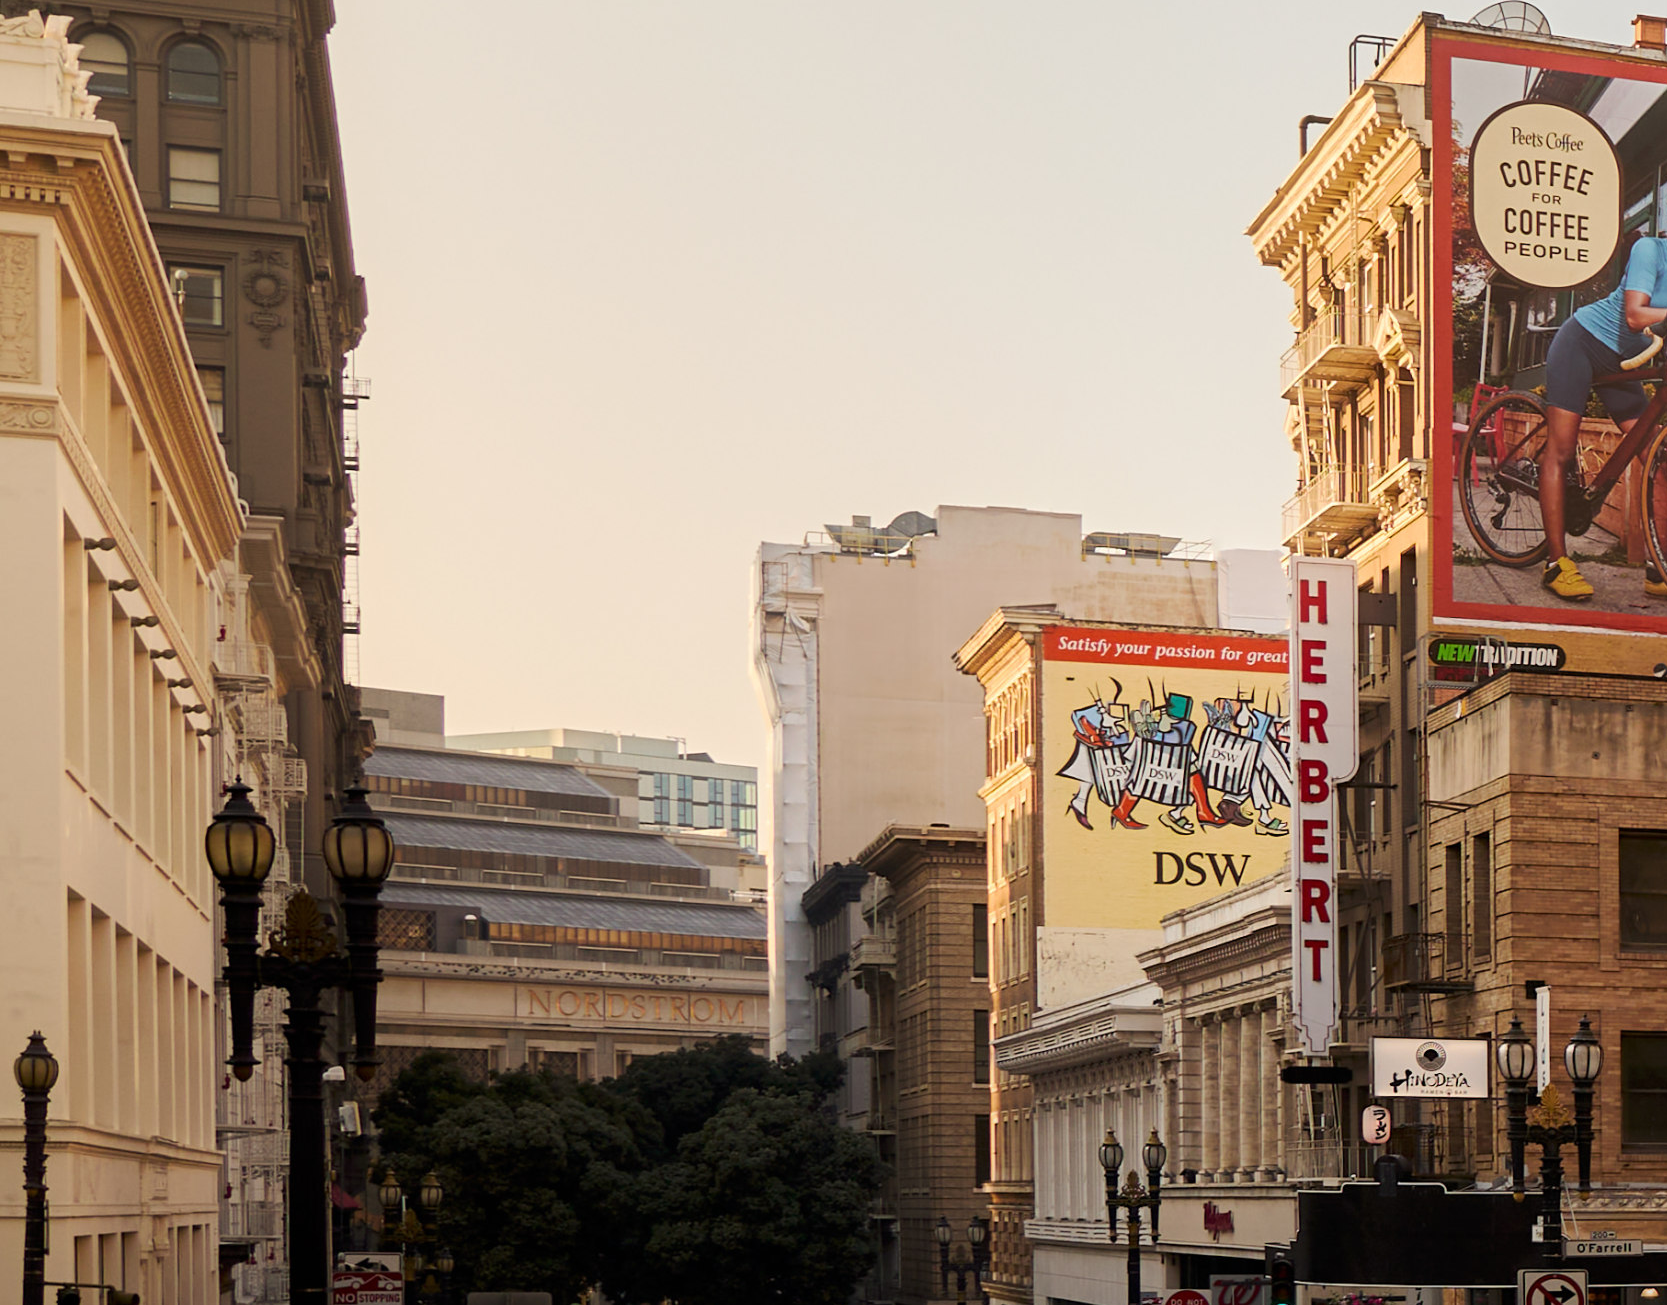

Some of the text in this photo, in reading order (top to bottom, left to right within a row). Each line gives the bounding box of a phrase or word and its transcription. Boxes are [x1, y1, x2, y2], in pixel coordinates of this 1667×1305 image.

[1546, 132, 1584, 153] Coffee
[1500, 160, 1594, 195] COFFEE
[1532, 193, 1562, 205] FOR
[1504, 208, 1590, 242] COFFEE
[1504, 241, 1589, 263] PEOPLE
[1058, 636, 1288, 665] Satisfy your passion for great
[1211, 748, 1238, 762] DSW
[1106, 767, 1178, 781] DSW DSW
[1300, 578, 1329, 982] HERBERT
[1153, 851, 1251, 887] DSW
[528, 989, 744, 1024] NORDSTROM
[1373, 1109, 1387, 1140] ラーメン
[1577, 1243, 1632, 1253] O'Farrell
[335, 1293, 400, 1303] NO STOPPING
